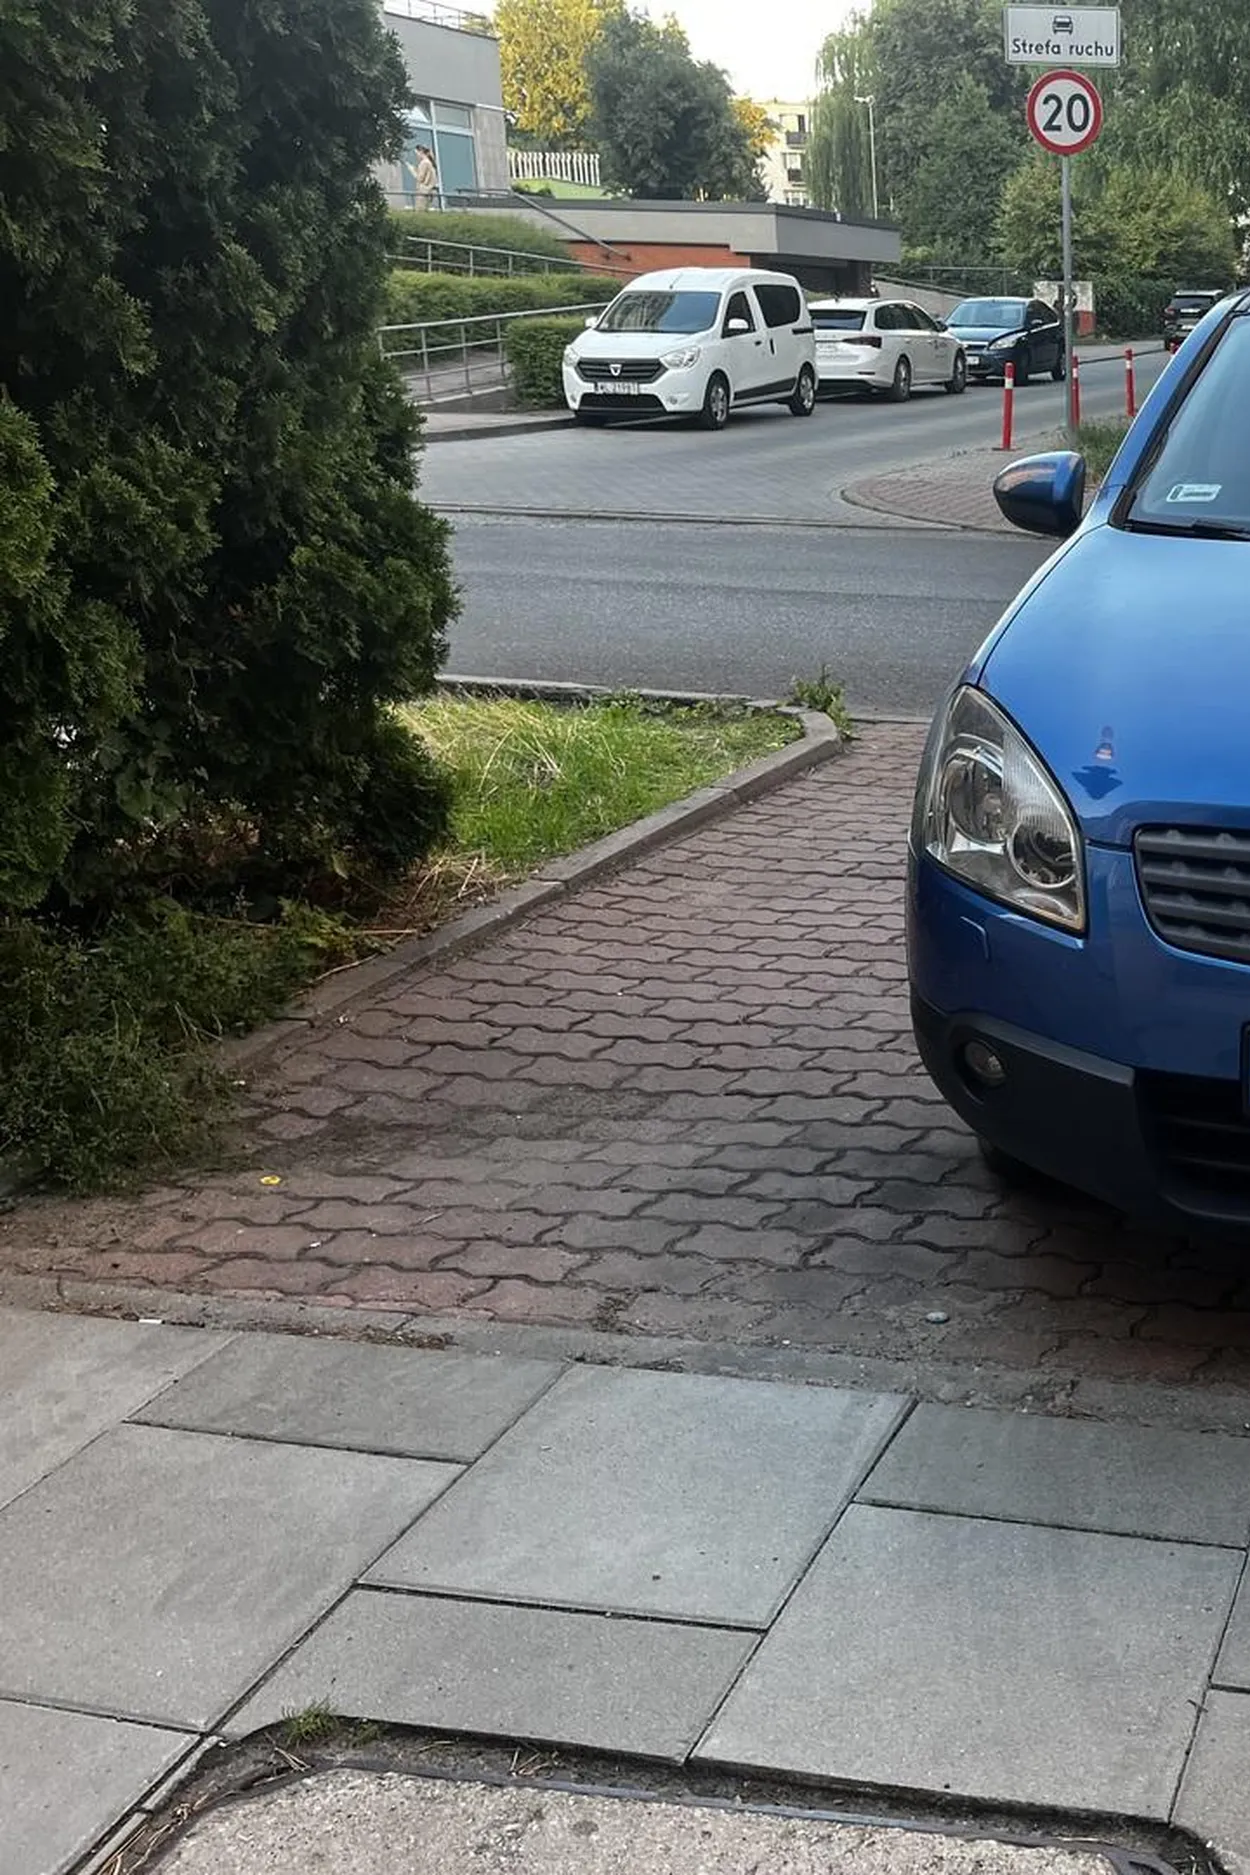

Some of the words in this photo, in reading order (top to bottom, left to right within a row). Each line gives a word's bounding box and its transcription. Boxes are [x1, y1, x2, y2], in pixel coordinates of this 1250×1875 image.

[1011, 38, 1062, 55] Strefa
[1069, 41, 1115, 57] ruchu
[1042, 92, 1090, 133] 20
